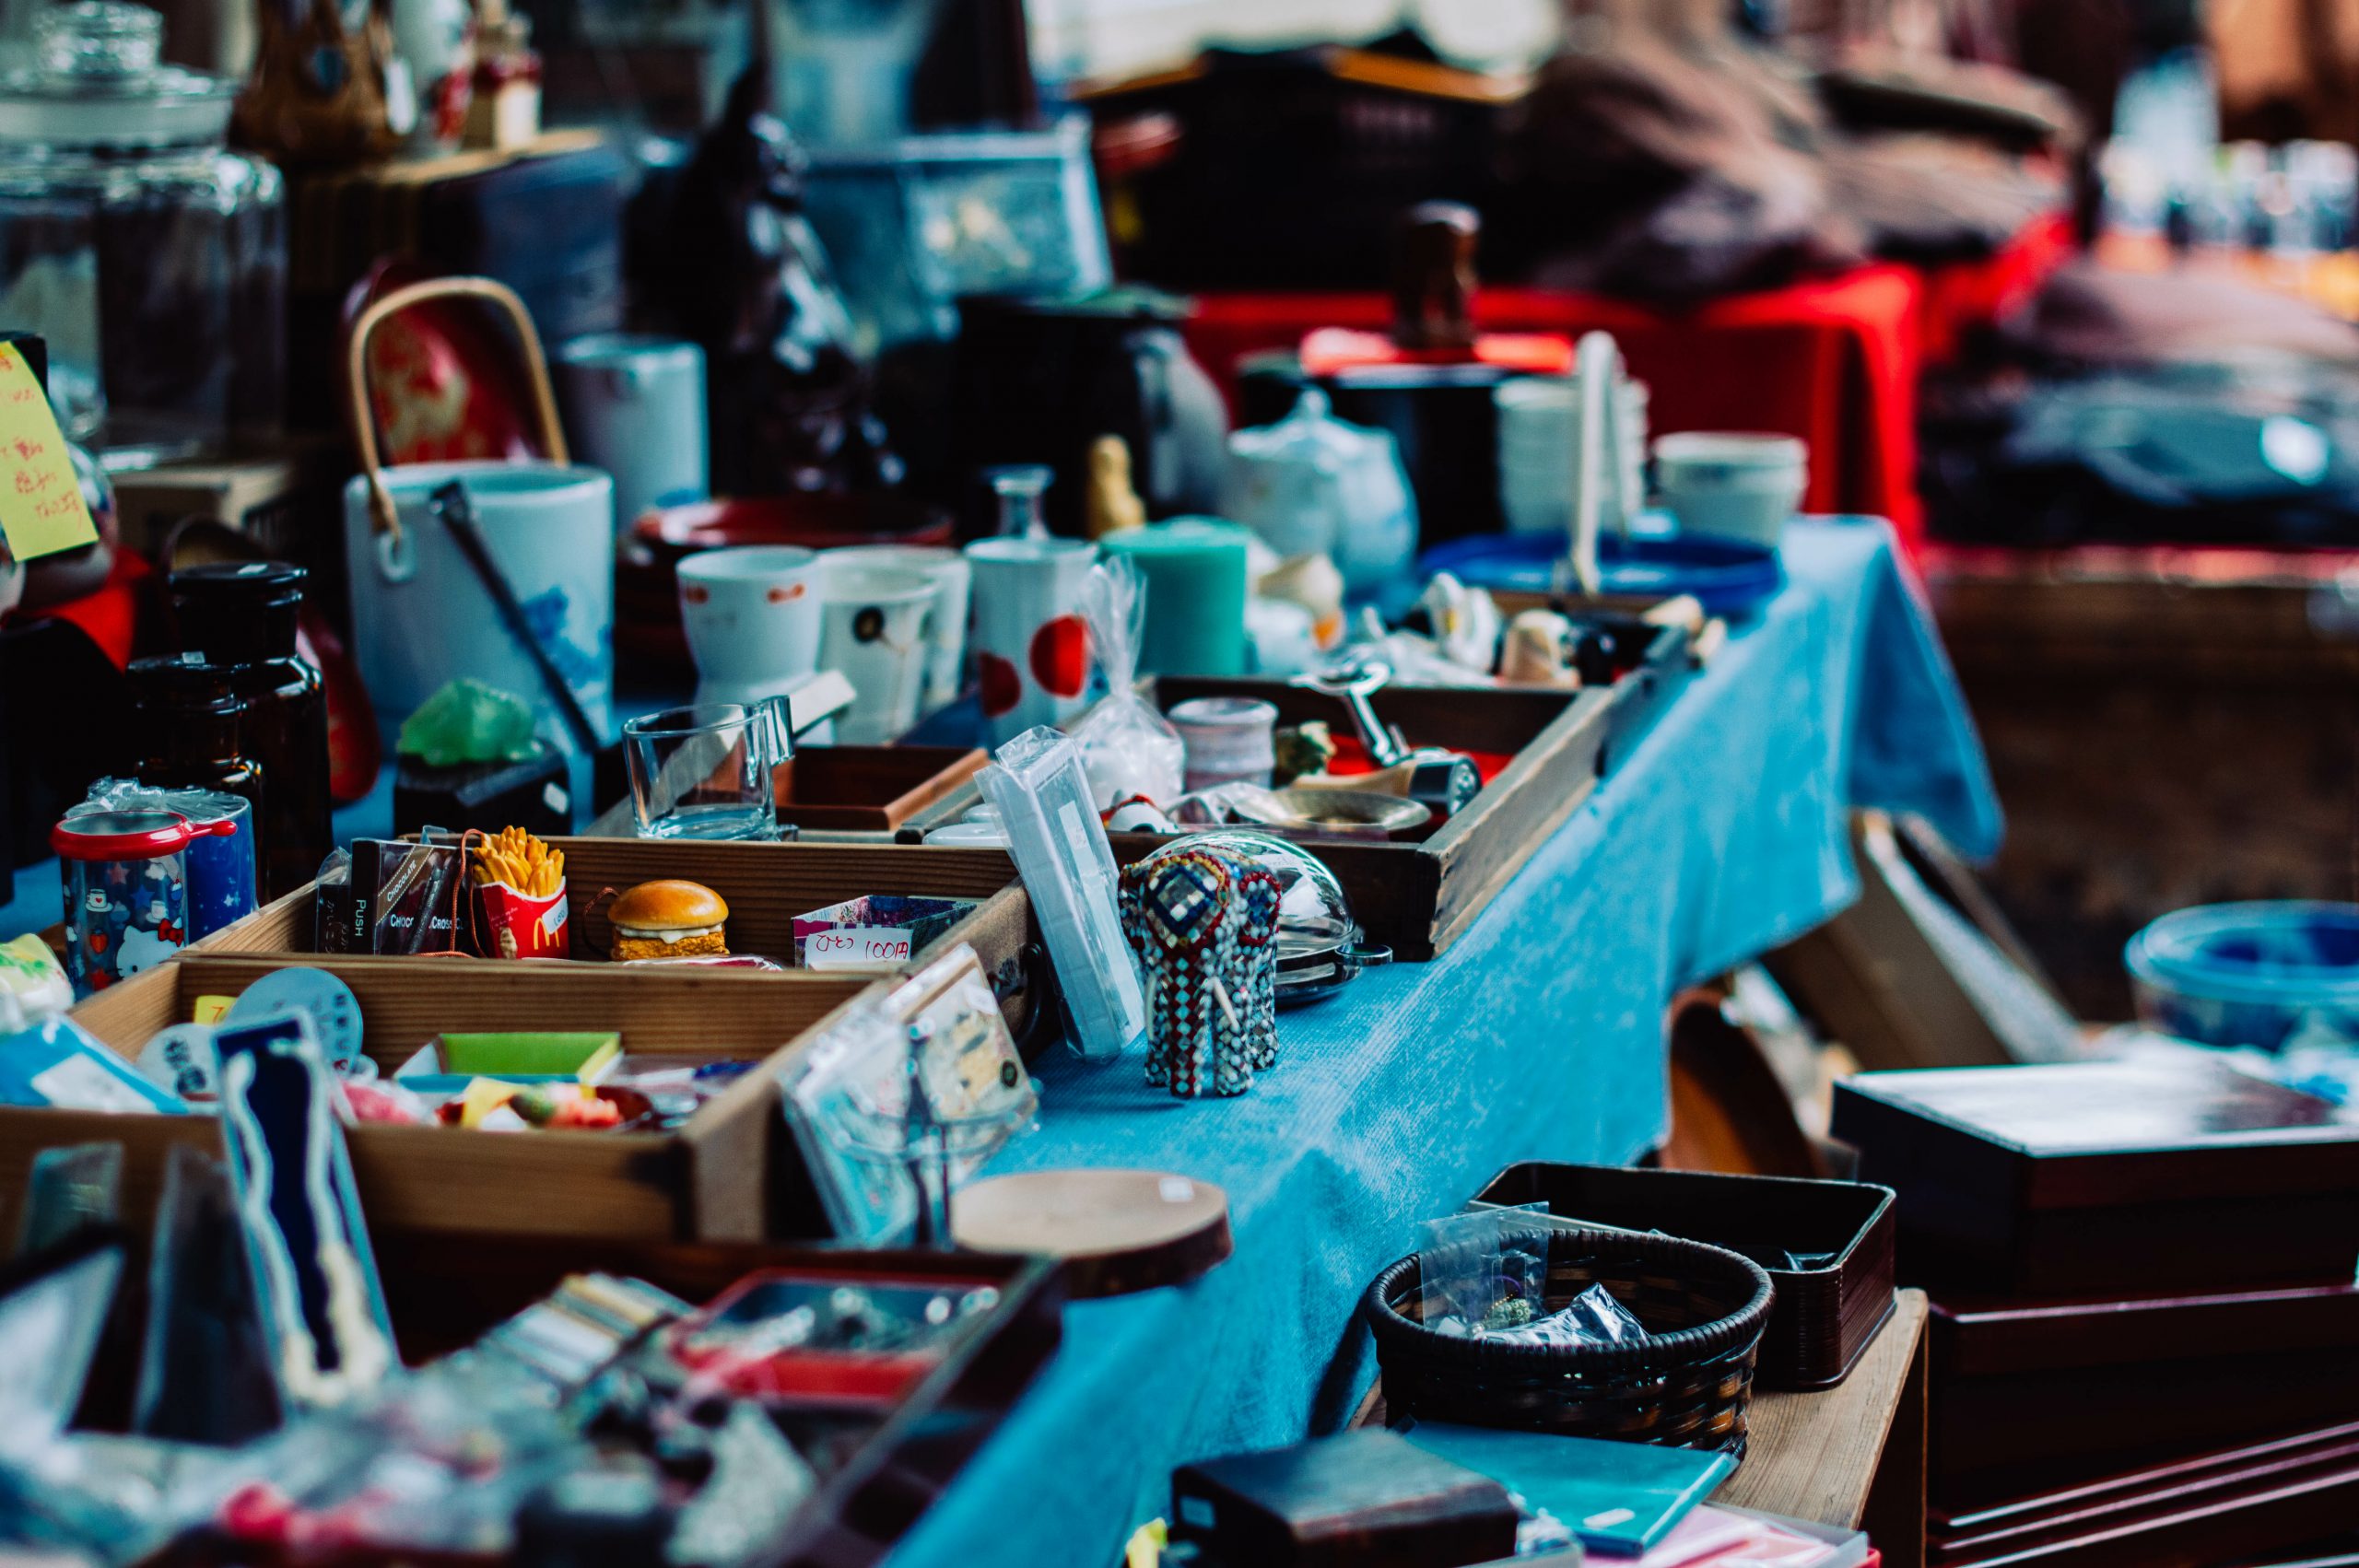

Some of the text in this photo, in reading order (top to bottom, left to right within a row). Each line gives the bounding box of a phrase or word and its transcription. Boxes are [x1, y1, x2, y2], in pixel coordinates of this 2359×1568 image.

[387, 860, 417, 902] CHOCOLATE
[355, 899, 367, 937] PUSH
[865, 941, 909, 960] 100円
